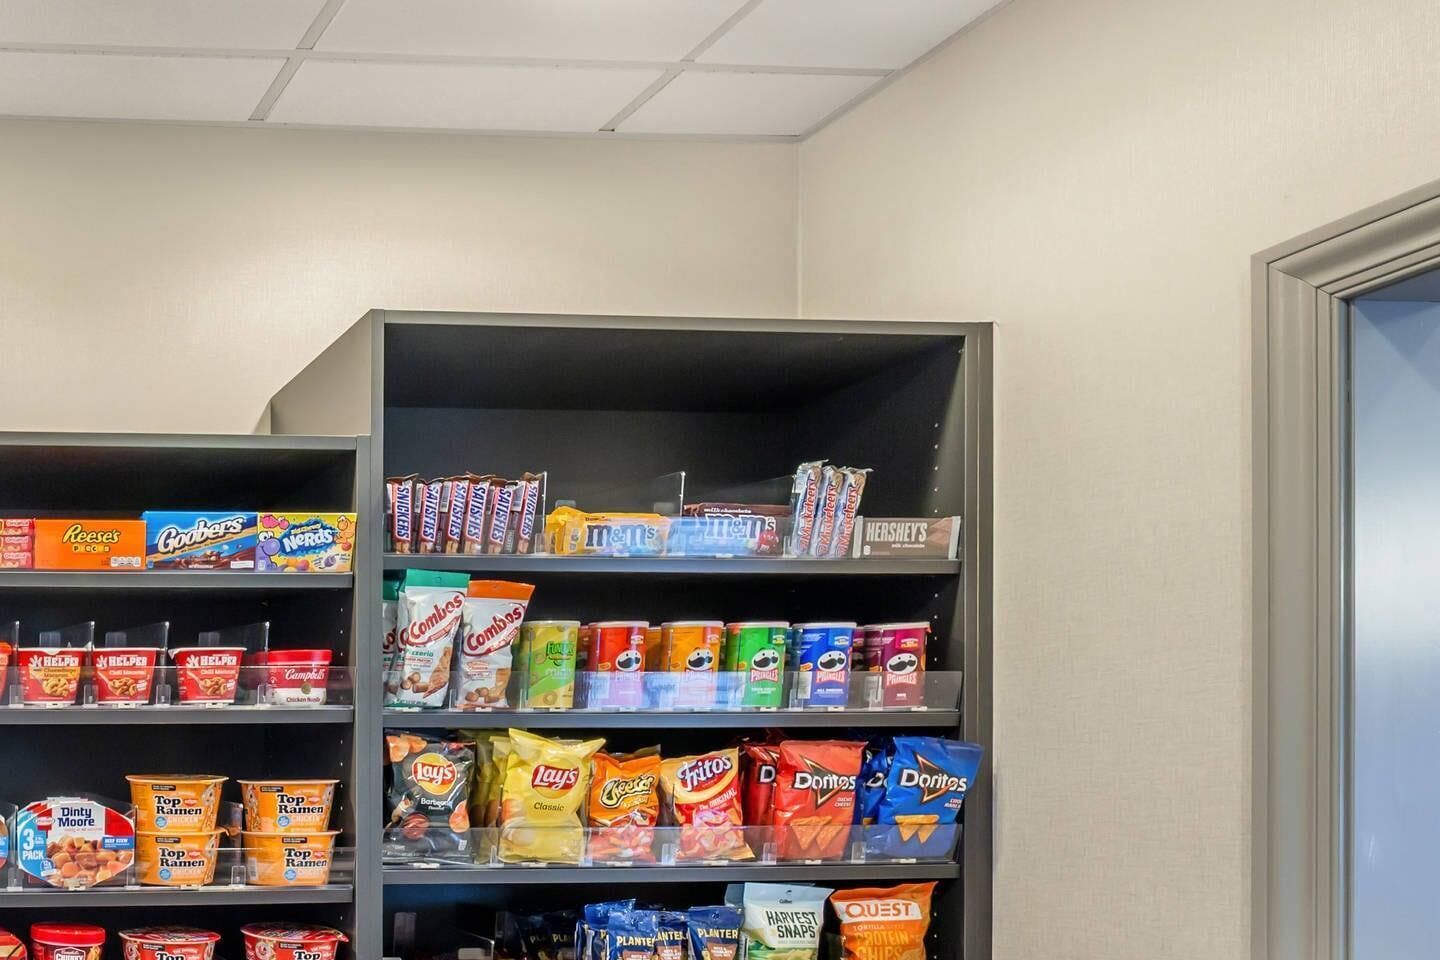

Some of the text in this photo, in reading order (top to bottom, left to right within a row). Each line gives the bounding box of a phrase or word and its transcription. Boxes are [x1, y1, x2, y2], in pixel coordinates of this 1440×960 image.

[396, 486, 410, 538] SNICKERS
[422, 485, 440, 541] SATISFIES
[448, 483, 466, 540] SATISFIES
[465, 484, 487, 541] SATISFIES
[491, 489, 511, 544] SATISFIES
[520, 485, 538, 540] SNICKERS
[63, 524, 121, 544] Reese's
[157, 515, 245, 554] Goobers
[866, 522, 927, 542] HERSHEY'S
[409, 594, 463, 639] Combos
[467, 606, 522, 651] Combos
[44, 656, 78, 667] HELPER
[109, 656, 147, 666] HELPER
[201, 656, 237, 666] HELPER
[751, 669, 778, 682] PRINGLES
[816, 670, 845, 683] PRINGLES
[886, 672, 917, 685] PRINGLES
[417, 762, 453, 785] Lay's
[534, 764, 579, 789] Lay's
[677, 755, 732, 792] Fritos
[794, 772, 856, 790] Doritos
[900, 769, 967, 792] Doritos
[155, 795, 181, 808] Top
[278, 794, 305, 807] Top
[534, 802, 564, 812] Classic
[61, 807, 92, 819] Dinty
[156, 806, 202, 815] Ramen
[278, 805, 323, 814] Ramen
[58, 816, 95, 827] Moore
[23, 830, 34, 850] 3
[22, 851, 44, 861] PACK
[160, 848, 185, 860] Top
[285, 848, 311, 860] Top
[160, 858, 205, 867] Ramen
[286, 859, 327, 868] Ramen
[845, 903, 913, 919] QUEST
[766, 911, 818, 927] HARVEST
[777, 925, 816, 939] SNAPS
[857, 931, 908, 946] PROTEIN
